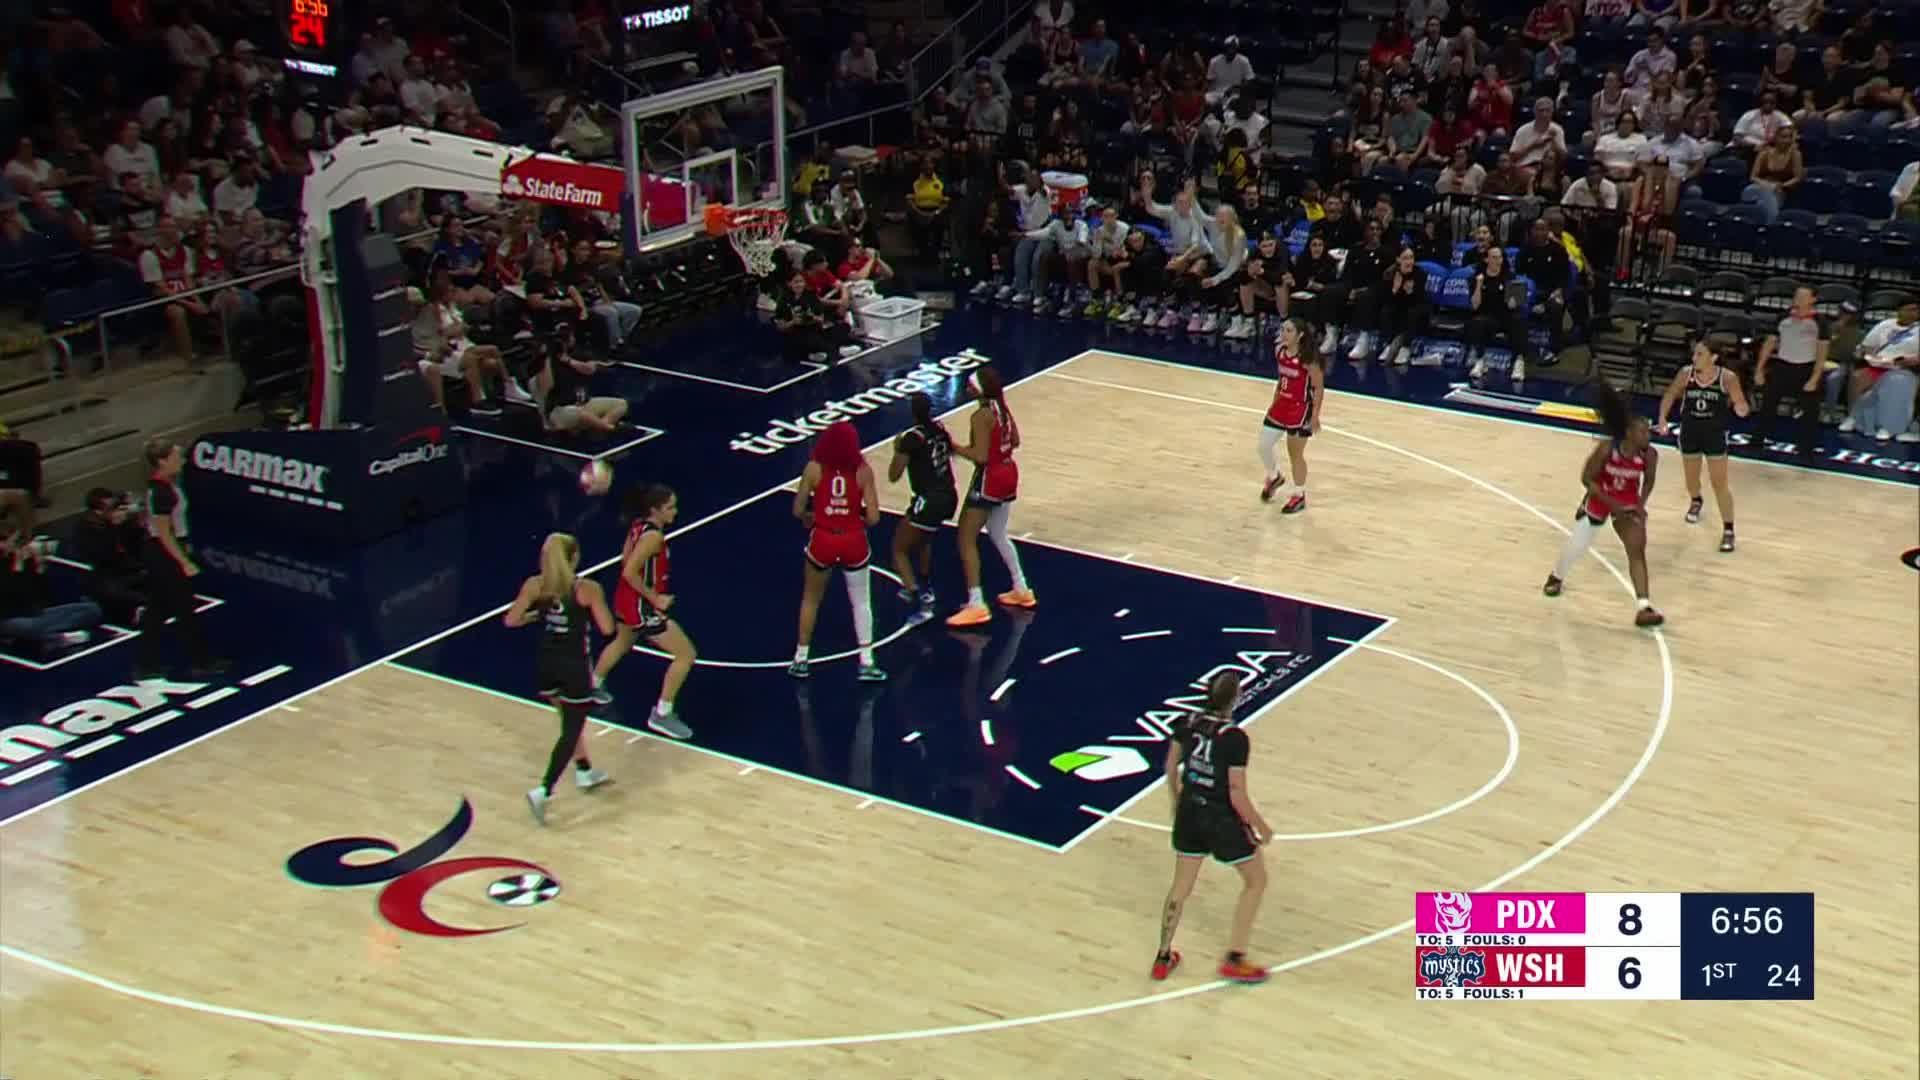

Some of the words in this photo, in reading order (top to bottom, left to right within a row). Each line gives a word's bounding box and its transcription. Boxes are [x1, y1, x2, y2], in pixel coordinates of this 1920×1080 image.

[291, 14, 325, 46] 24
[642, 5, 690, 29] TISSOT
[729, 347, 992, 455] ticketmaster
[1695, 399, 1707, 412] 0
[831, 475, 846, 497] 0
[1191, 732, 1212, 762] 21
